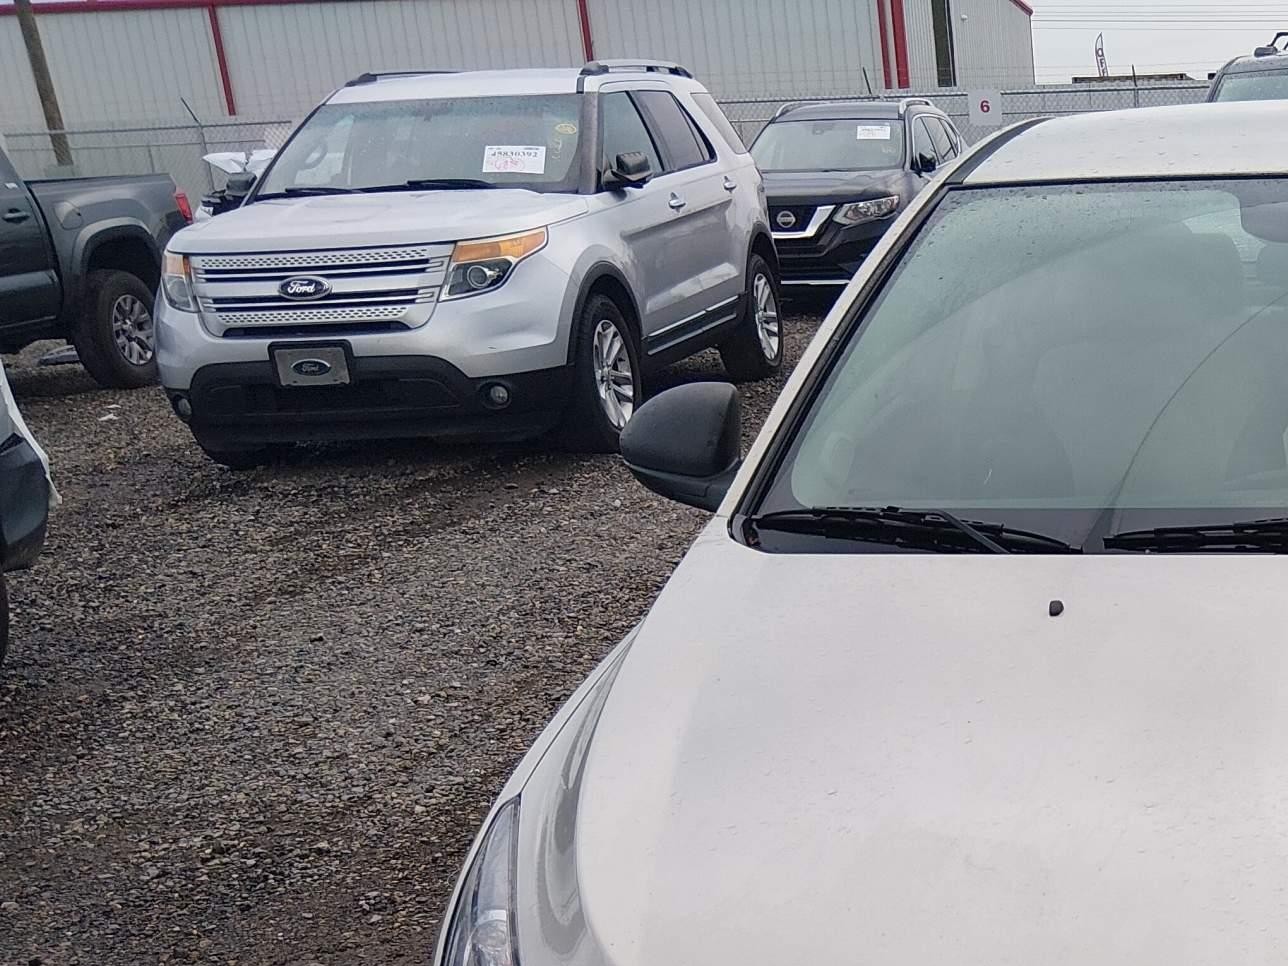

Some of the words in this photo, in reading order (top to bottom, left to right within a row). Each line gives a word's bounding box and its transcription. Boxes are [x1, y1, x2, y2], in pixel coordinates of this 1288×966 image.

[979, 100, 990, 113] 6
[287, 280, 316, 294] Ford
[301, 362, 319, 373] Ford
